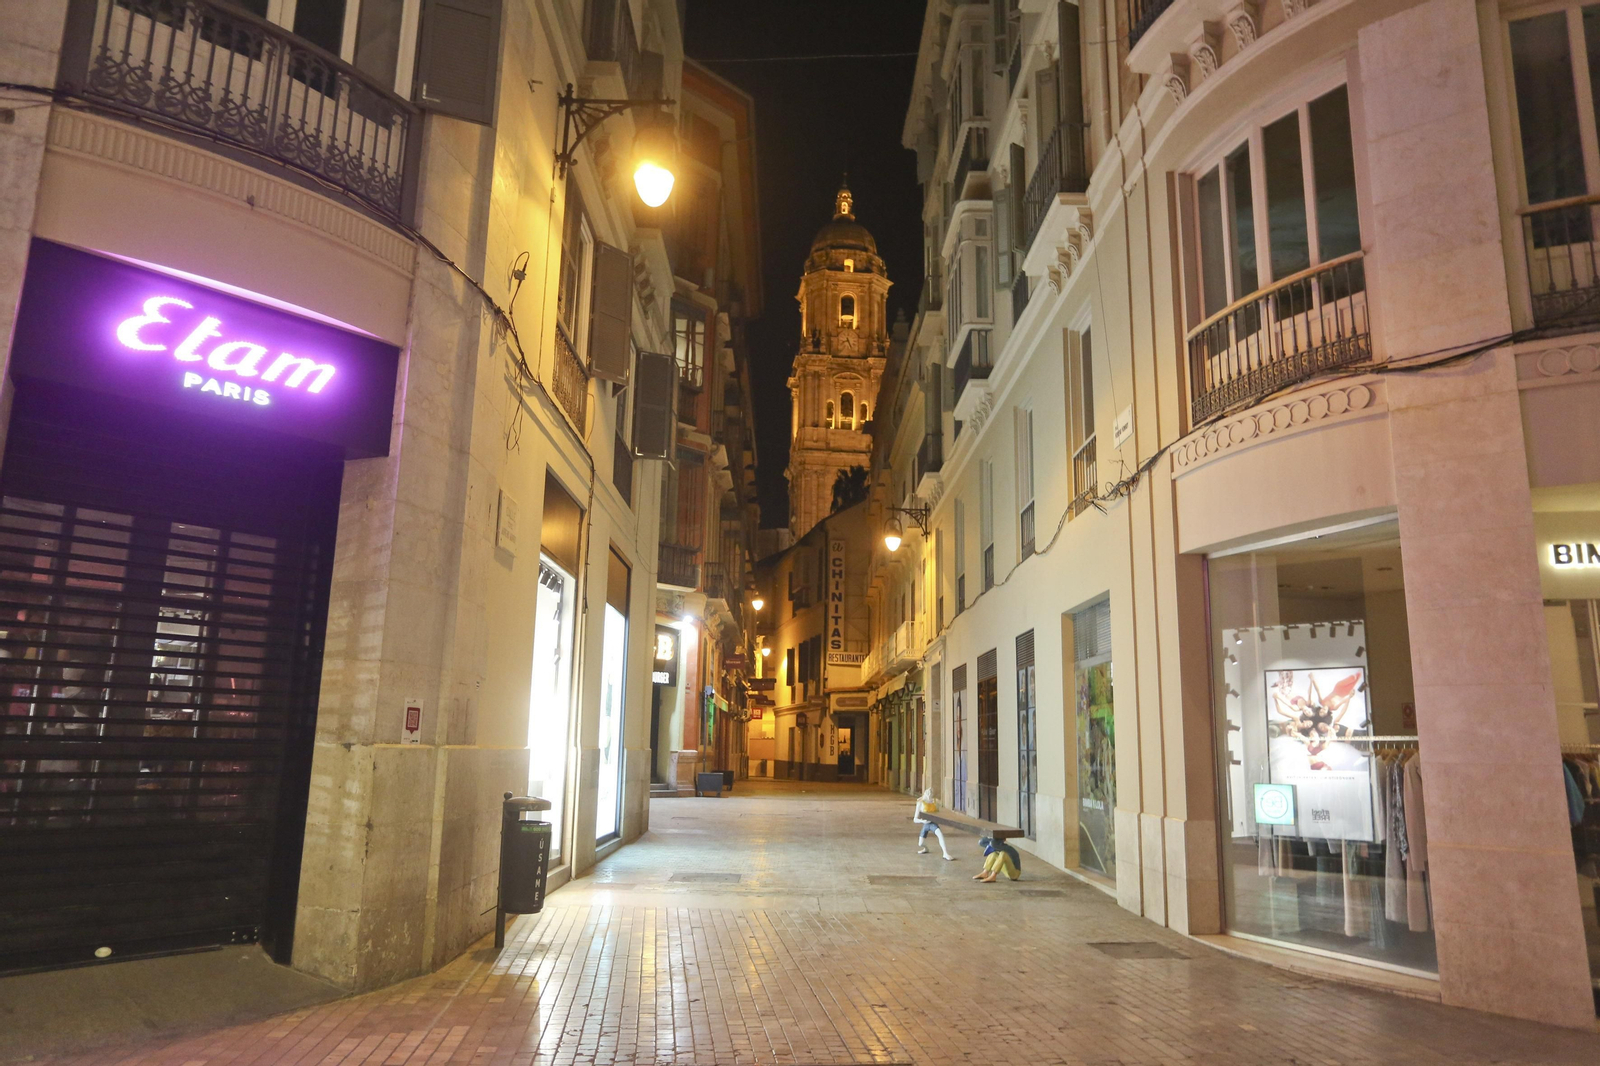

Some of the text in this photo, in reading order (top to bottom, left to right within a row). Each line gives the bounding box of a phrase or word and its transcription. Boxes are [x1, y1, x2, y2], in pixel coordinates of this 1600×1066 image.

[116, 296, 336, 394] Etam
[183, 371, 271, 405] PARIS
[831, 557, 843, 650] CHINITAS
